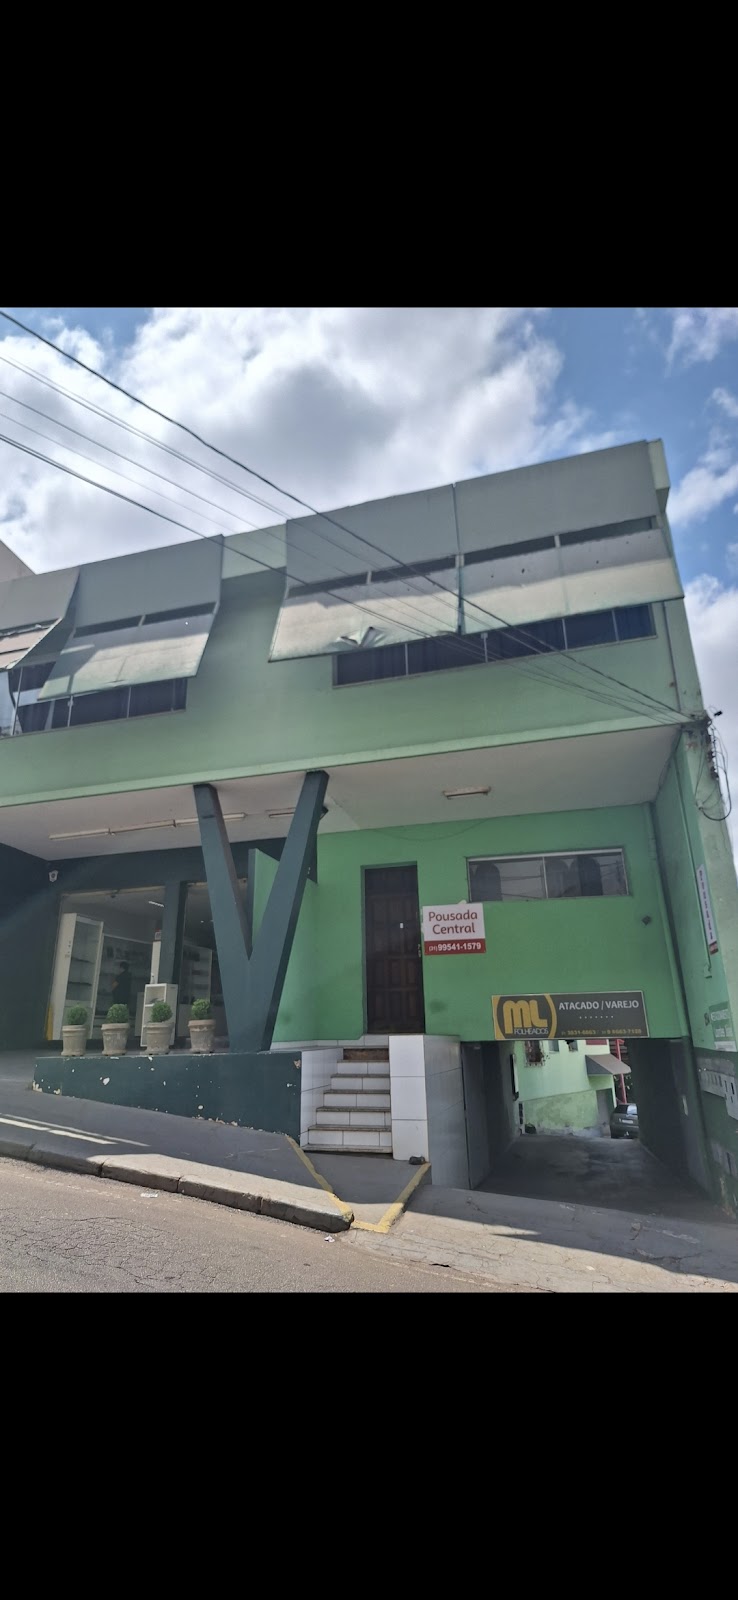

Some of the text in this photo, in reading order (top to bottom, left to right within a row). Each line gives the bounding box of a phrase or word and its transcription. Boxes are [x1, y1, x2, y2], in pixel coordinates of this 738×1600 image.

[428, 909, 478, 921] Pousada
[432, 922, 475, 935] Central
[558, 1001, 600, 1011] ATACADO
[606, 1000, 639, 1009] VAREJO
[514, 1027, 549, 1036] FOLHEADOS
